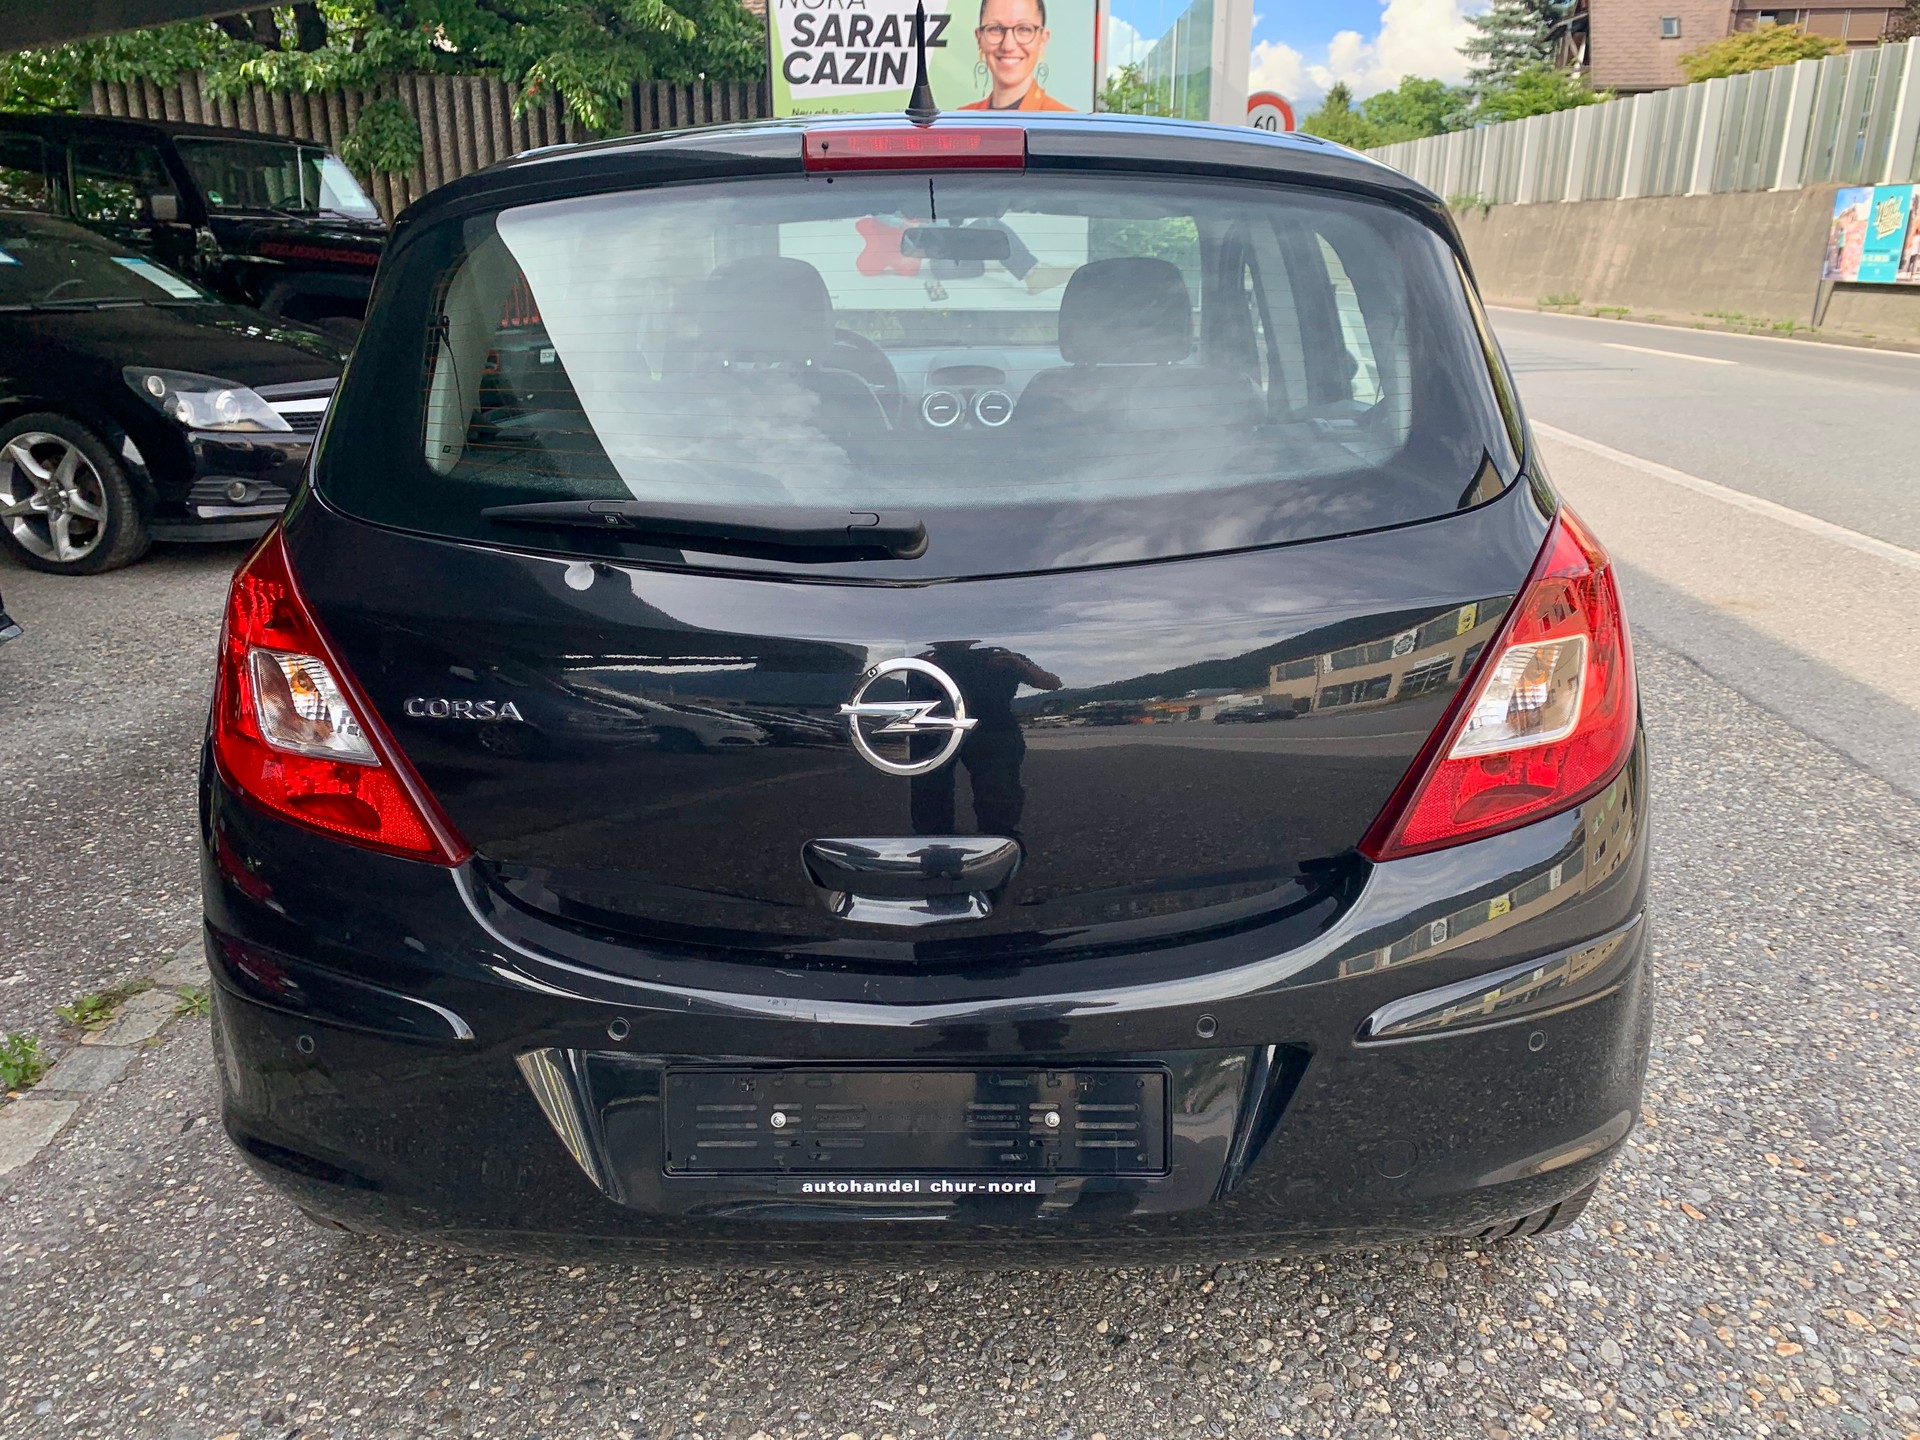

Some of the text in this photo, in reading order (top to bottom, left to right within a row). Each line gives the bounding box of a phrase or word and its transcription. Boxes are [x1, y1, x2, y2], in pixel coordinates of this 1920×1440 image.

[791, 13, 952, 47] SARATZ
[782, 51, 908, 85] CAZIN
[1254, 115, 1277, 132] 60
[403, 698, 524, 721] CORSA
[802, 1180, 1036, 1193] autohandel chur-nord
